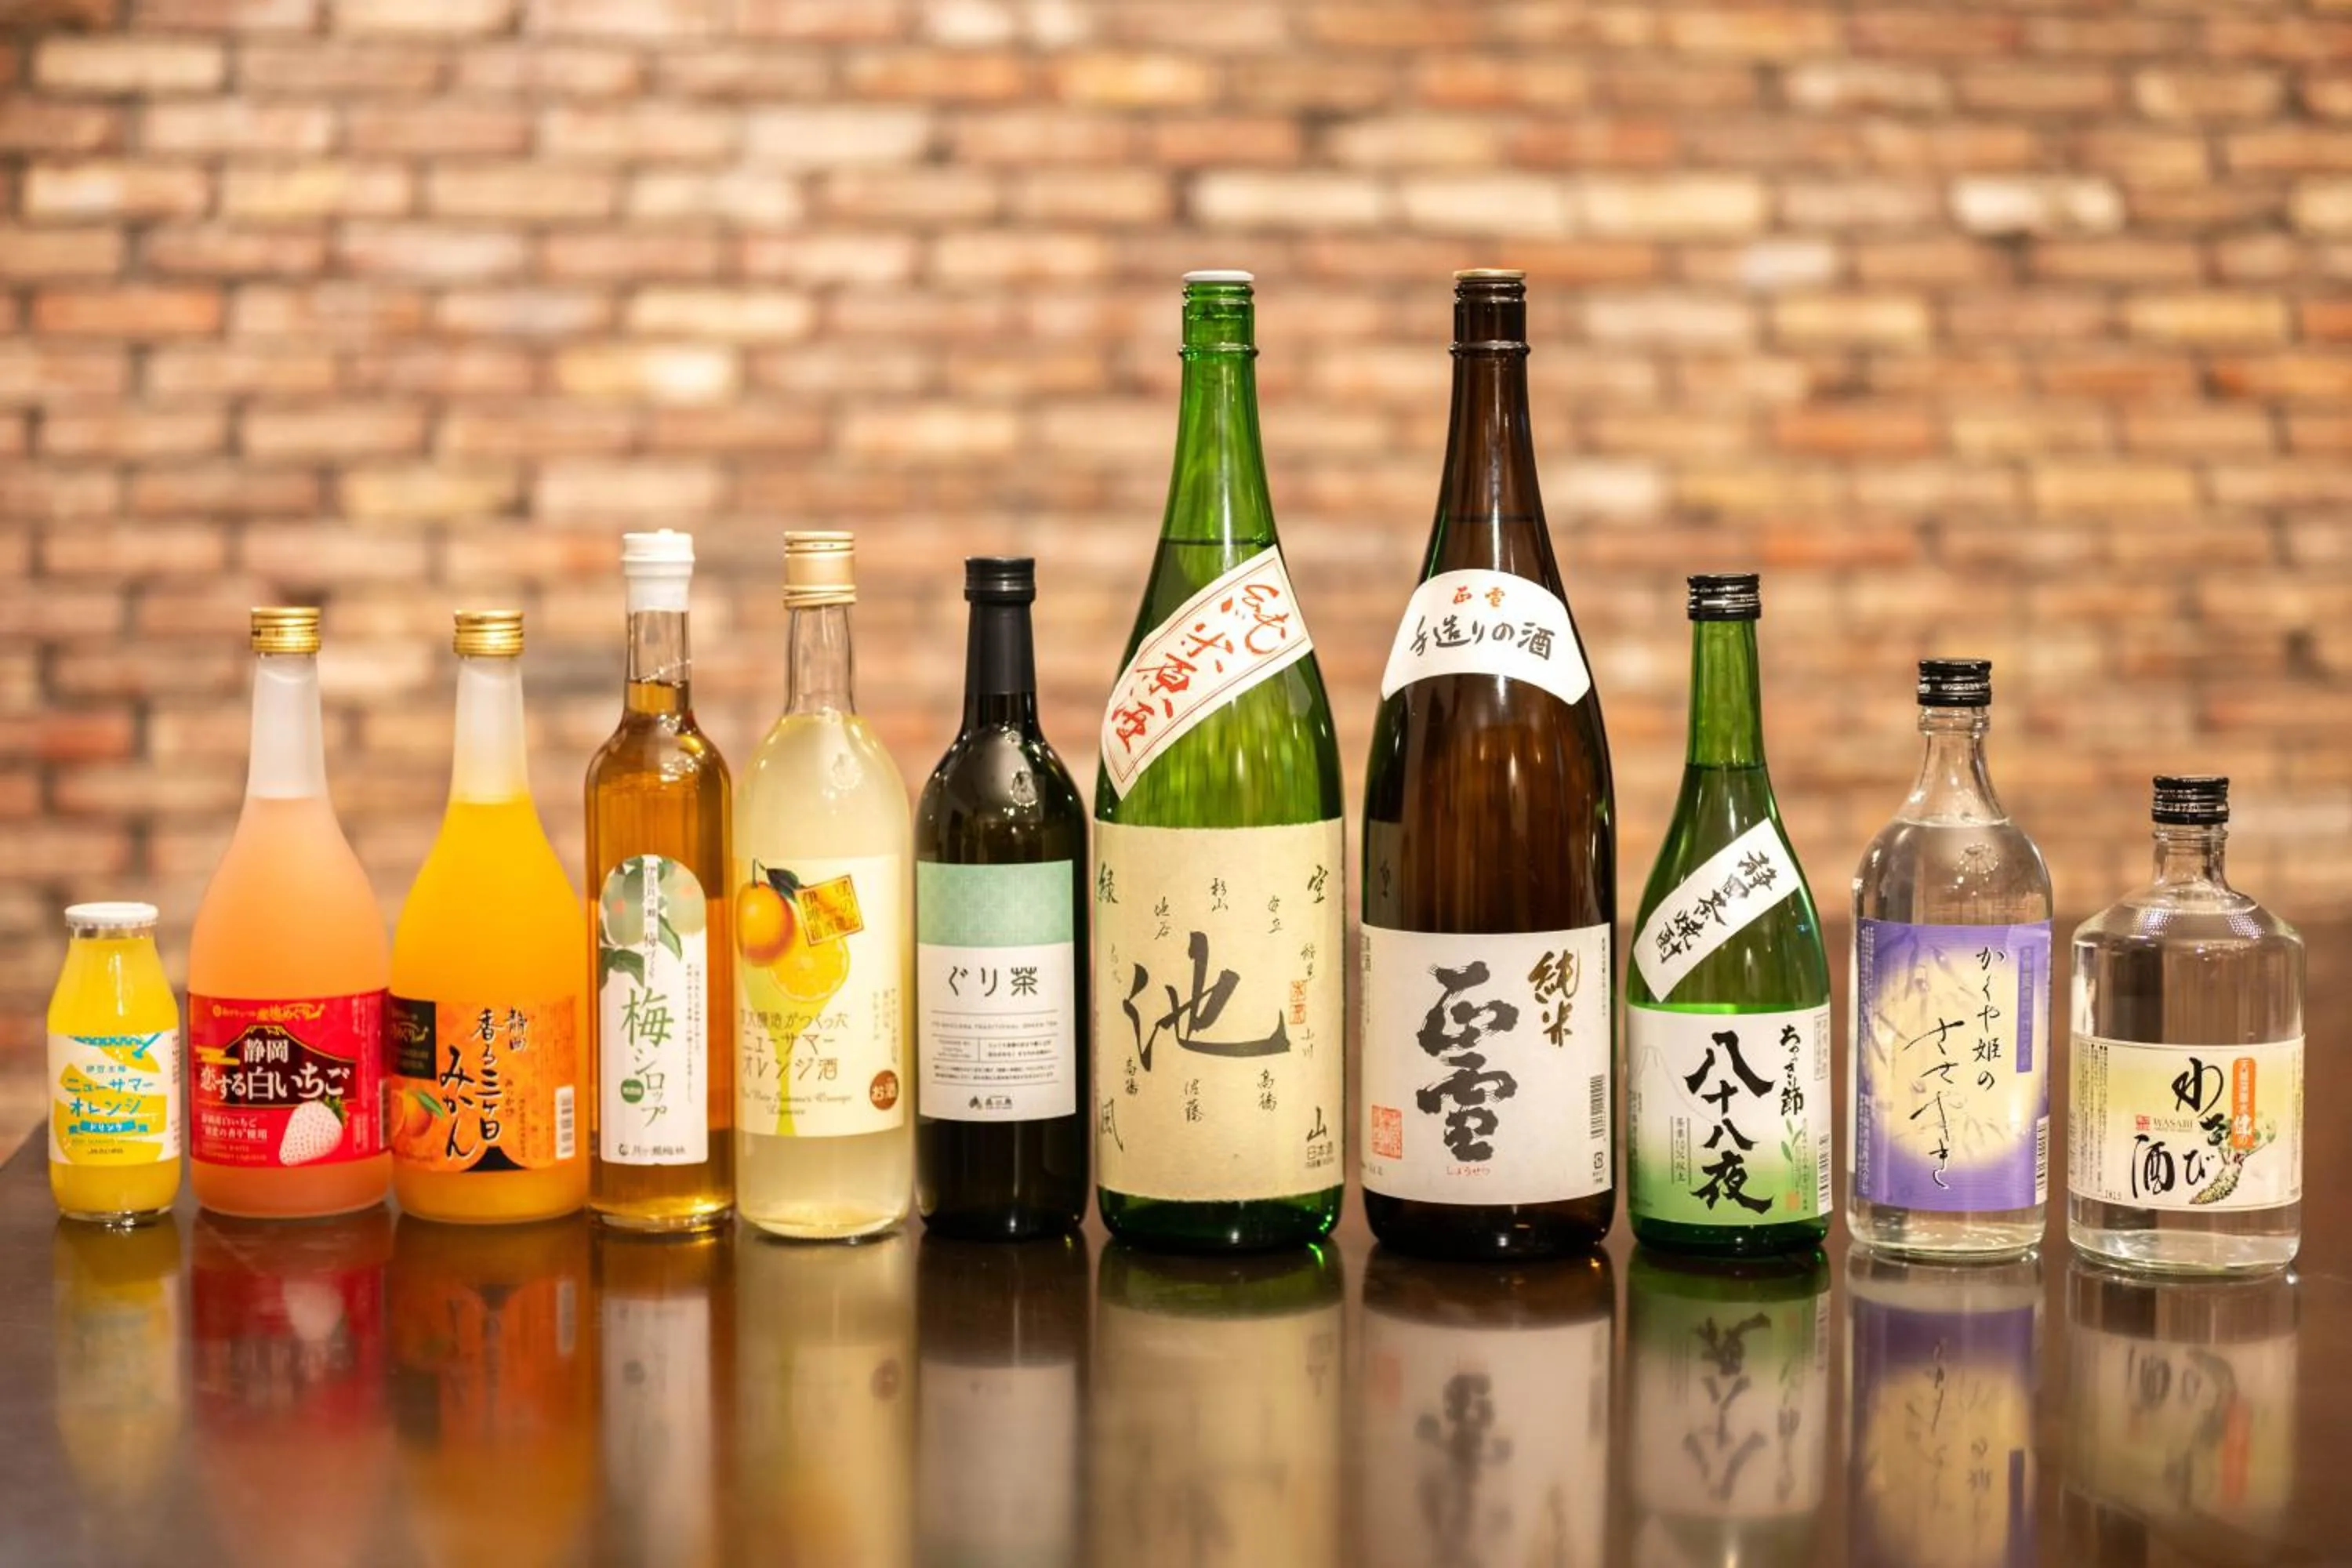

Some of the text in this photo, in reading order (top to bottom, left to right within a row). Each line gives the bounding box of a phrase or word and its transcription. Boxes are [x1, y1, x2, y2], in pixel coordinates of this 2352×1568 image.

[1453, 585, 1506, 608] 正雪
[1410, 614, 1555, 661] 手造りの酒
[1656, 850, 1777, 965] 静岡茶焼酎
[948, 965, 1039, 997] ぐり茶
[1528, 948, 1581, 1047] 純米
[1122, 930, 1291, 1073] 池
[244, 1039, 289, 1064] 静岡
[620, 986, 675, 1130] 梅シロップ
[742, 1030, 836, 1055] ニューサマー
[1416, 960, 1519, 1163] 正雪
[64, 1077, 154, 1094] ニューサマー
[200, 1062, 350, 1101] 恋する白いちご
[743, 1055, 839, 1081] オレンジ酒
[69, 1096, 143, 1116] オレンジ
[439, 1044, 477, 1158] みかん
[1682, 1029, 1777, 1215] 八十八夜
[2154, 1117, 2194, 1129] WASABI
